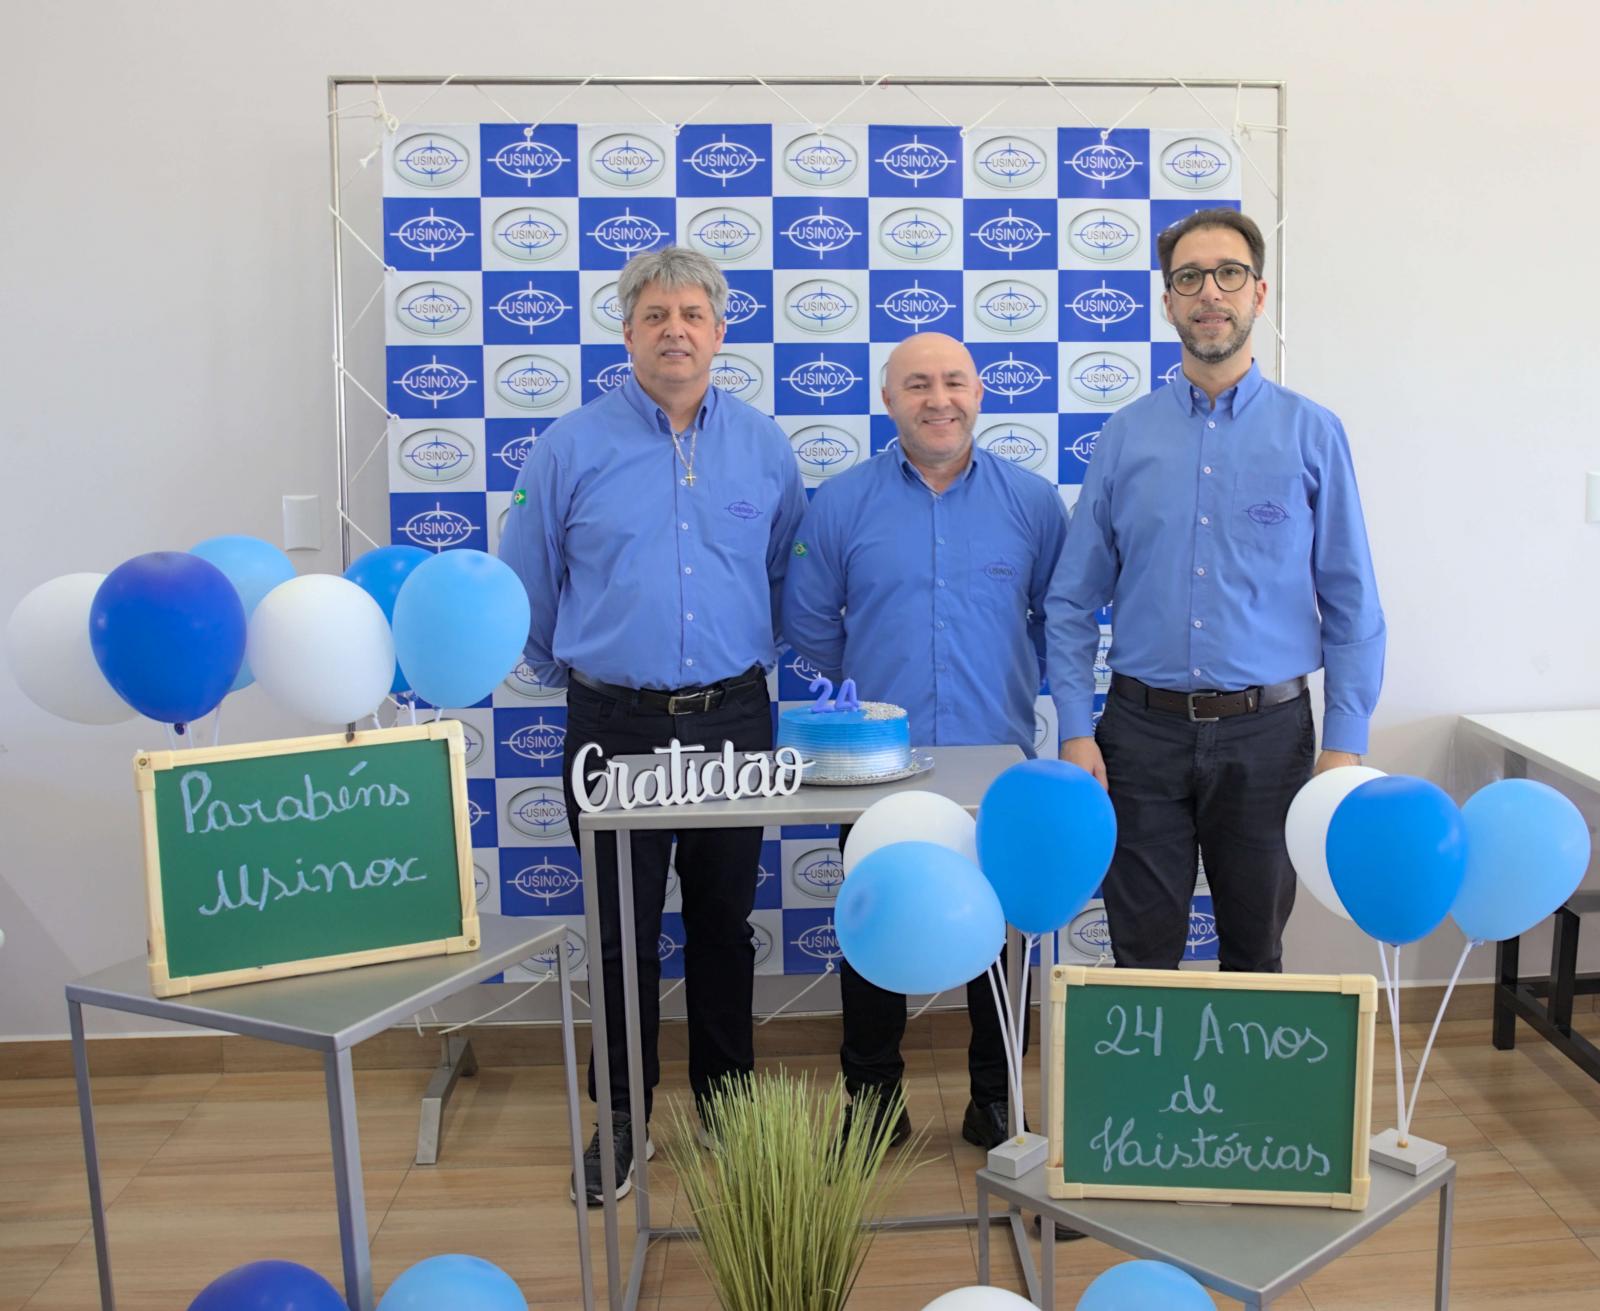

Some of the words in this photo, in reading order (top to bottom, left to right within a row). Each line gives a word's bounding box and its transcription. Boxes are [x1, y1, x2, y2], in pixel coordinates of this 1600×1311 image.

[413, 156, 450, 166] USINOX
[505, 154, 554, 166] USINOX
[609, 156, 646, 166] USINOX
[700, 154, 749, 166] USINOX
[802, 156, 839, 165] USINOX
[891, 155, 939, 167] USINOX
[992, 158, 1028, 168] USINOX
[1080, 156, 1127, 169] USINOX
[1178, 159, 1214, 169] USINOX
[407, 228, 456, 241] USINOX
[512, 230, 549, 240] USINOX
[603, 227, 652, 240] USINOX
[706, 230, 743, 239] USINOX
[797, 227, 845, 240] USINOX
[899, 230, 935, 239] USINOX
[987, 228, 1034, 240] USINOX
[1087, 230, 1122, 240] USINOX
[415, 304, 452, 314] USINOX
[506, 301, 555, 314] USINOX
[725, 300, 749, 313] NOX
[803, 302, 840, 311] USINOX
[892, 299, 939, 312] USINOX
[992, 302, 1028, 311] USINOX
[1080, 299, 1127, 312] USINOX
[410, 375, 459, 388] USINOX
[514, 377, 551, 387] USINOX
[605, 374, 630, 389] USI
[798, 372, 845, 385] USINOX
[987, 371, 1034, 384] USINOX
[1087, 373, 1122, 383] USINOX
[805, 447, 841, 456] USINOX
[993, 445, 1029, 454] USINOX
[419, 451, 455, 461] USINOX
[414, 522, 463, 535] USINOX
[809, 677, 860, 713] 24
[517, 736, 564, 748] USINOX
[572, 738, 816, 813] Gratidão
[180, 760, 410, 834] Parabéns
[526, 808, 563, 817] USINOX
[522, 875, 570, 888] USINOX
[1086, 927, 1110, 939] USIN
[1190, 923, 1215, 935] NOX
[1094, 1004, 1163, 1057] 24
[1193, 1002, 1328, 1063] Anos
[1158, 1074, 1223, 1114] de
